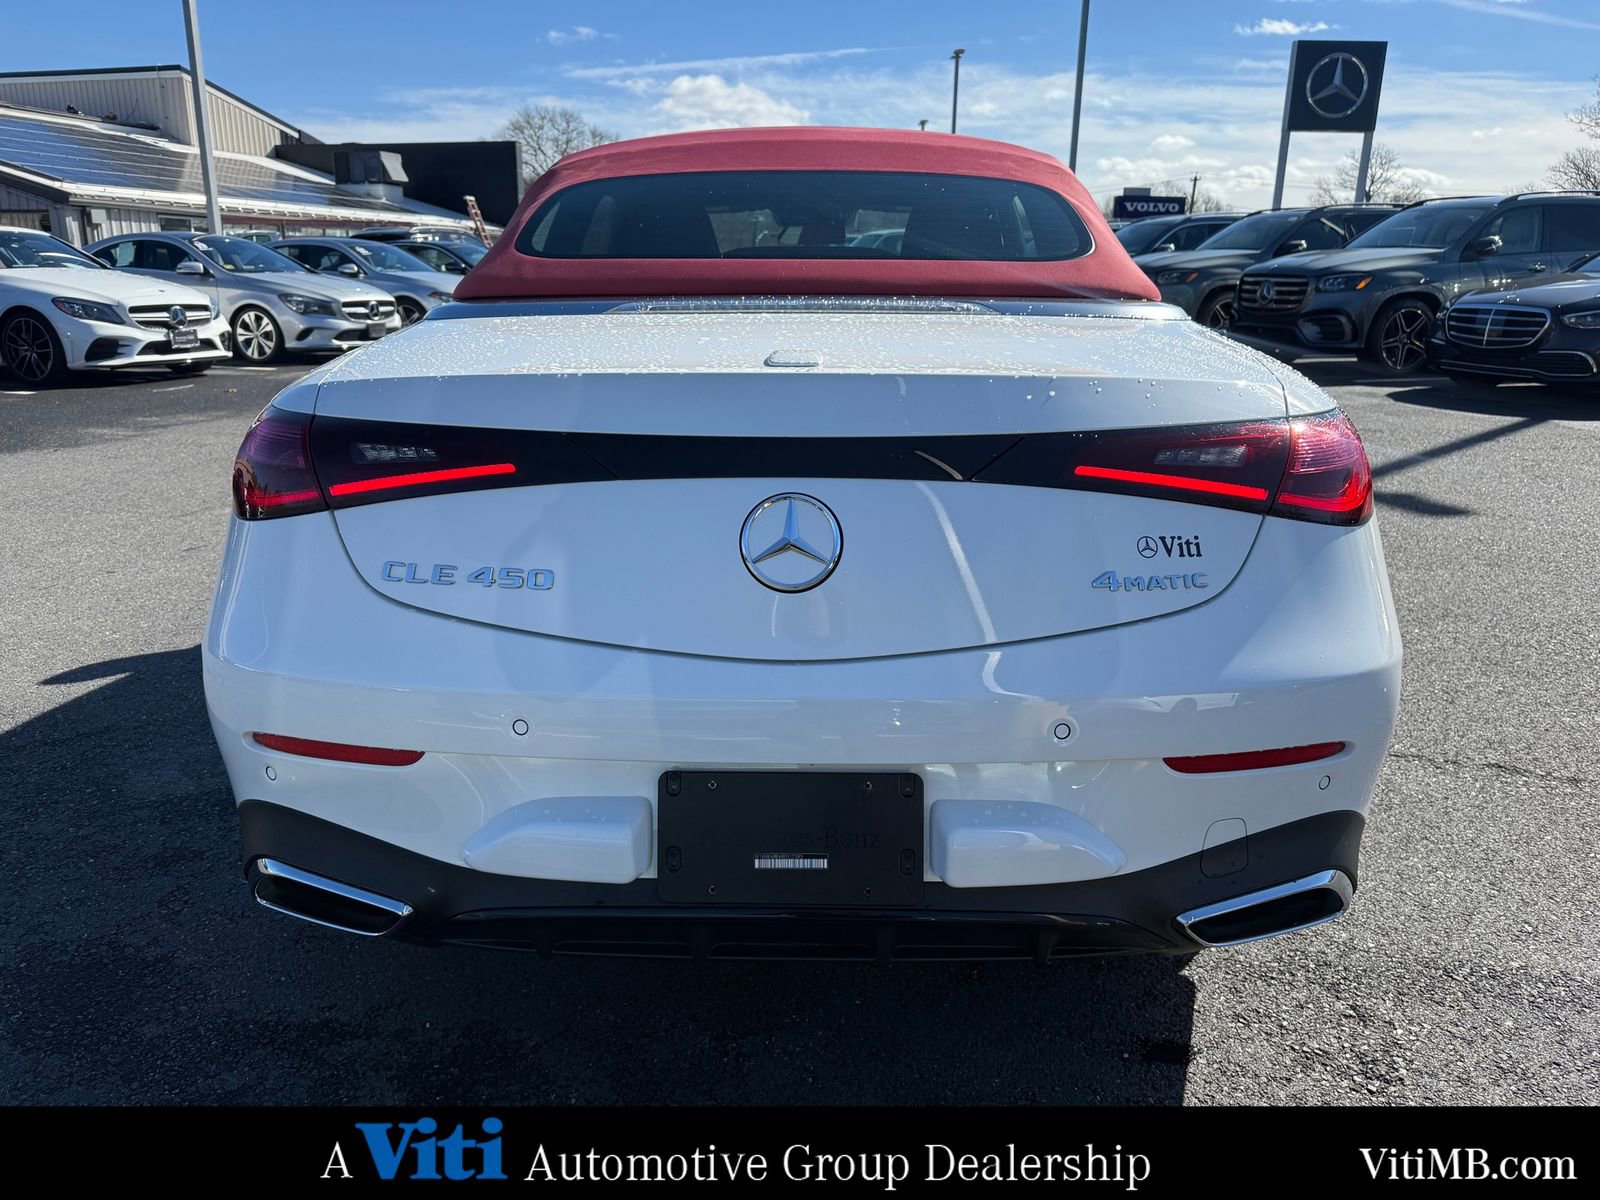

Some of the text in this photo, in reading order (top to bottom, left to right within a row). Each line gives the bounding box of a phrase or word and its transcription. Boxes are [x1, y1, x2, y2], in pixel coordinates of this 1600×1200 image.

[1124, 201, 1180, 213] VOLVO
[1158, 535, 1203, 558] Viti
[381, 560, 555, 591] CLE 450
[1091, 570, 1209, 592] 4MATIC
